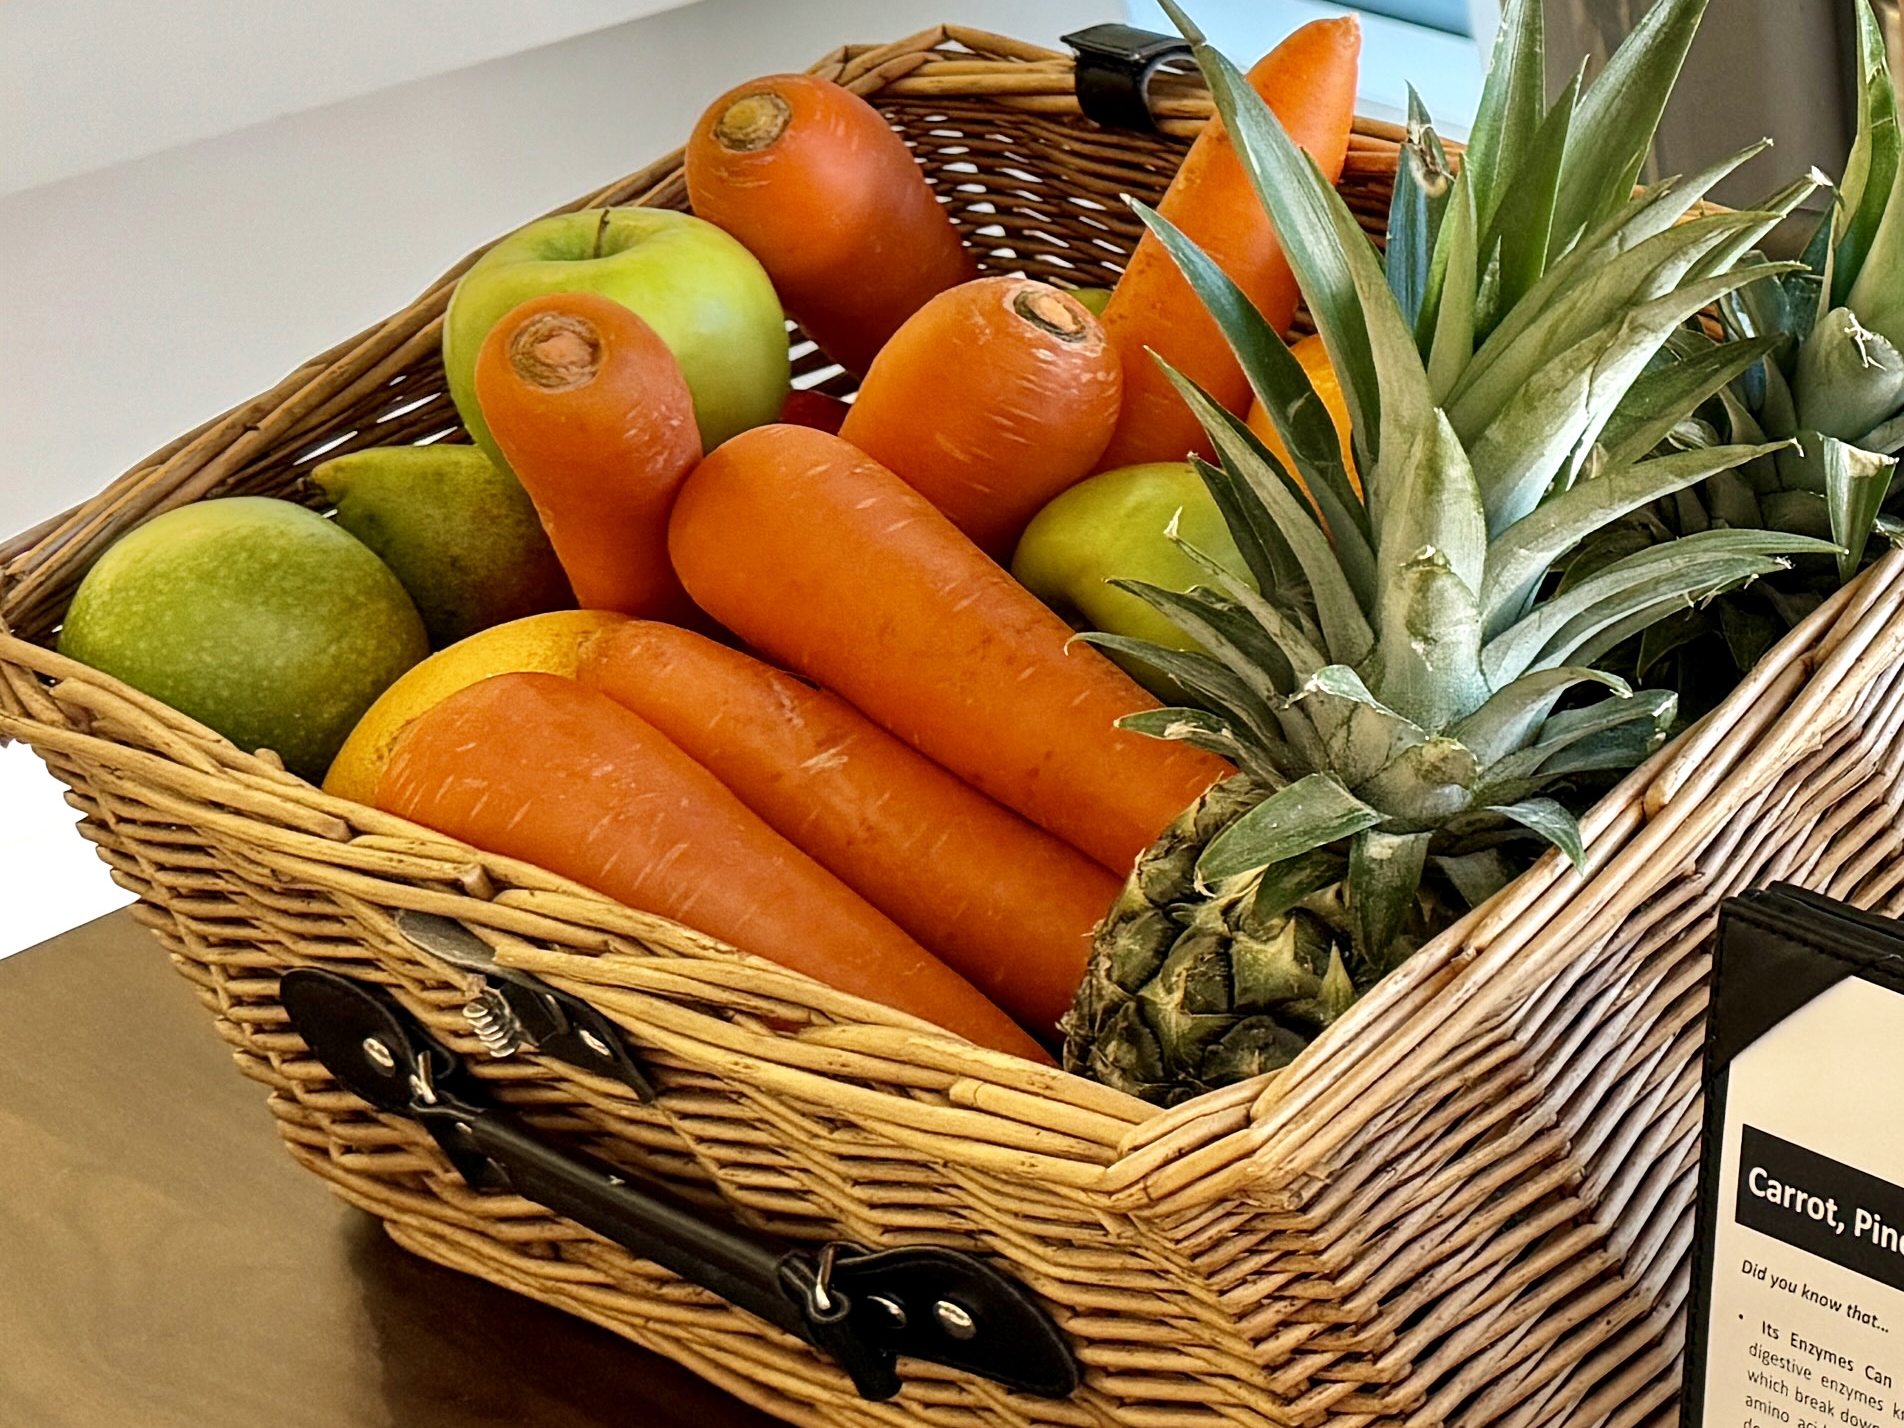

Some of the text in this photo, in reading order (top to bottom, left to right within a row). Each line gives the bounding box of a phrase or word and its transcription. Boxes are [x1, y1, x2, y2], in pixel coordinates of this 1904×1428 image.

[1747, 1165, 1845, 1235] Carrot,
[1740, 1258, 1768, 1282] Did
[1768, 1272, 1798, 1295] you
[1799, 1281, 1843, 1313] know
[1747, 1341, 1813, 1381] digestive
[1819, 1374, 1885, 1412] enzymes
[1760, 1318, 1780, 1341] Its
[1789, 1330, 1855, 1372] Enzymes
[1863, 1363, 1892, 1390] Can
[1744, 1393, 1790, 1424] amino
[1745, 1368, 1789, 1398] which
[1793, 1384, 1835, 1418] break
